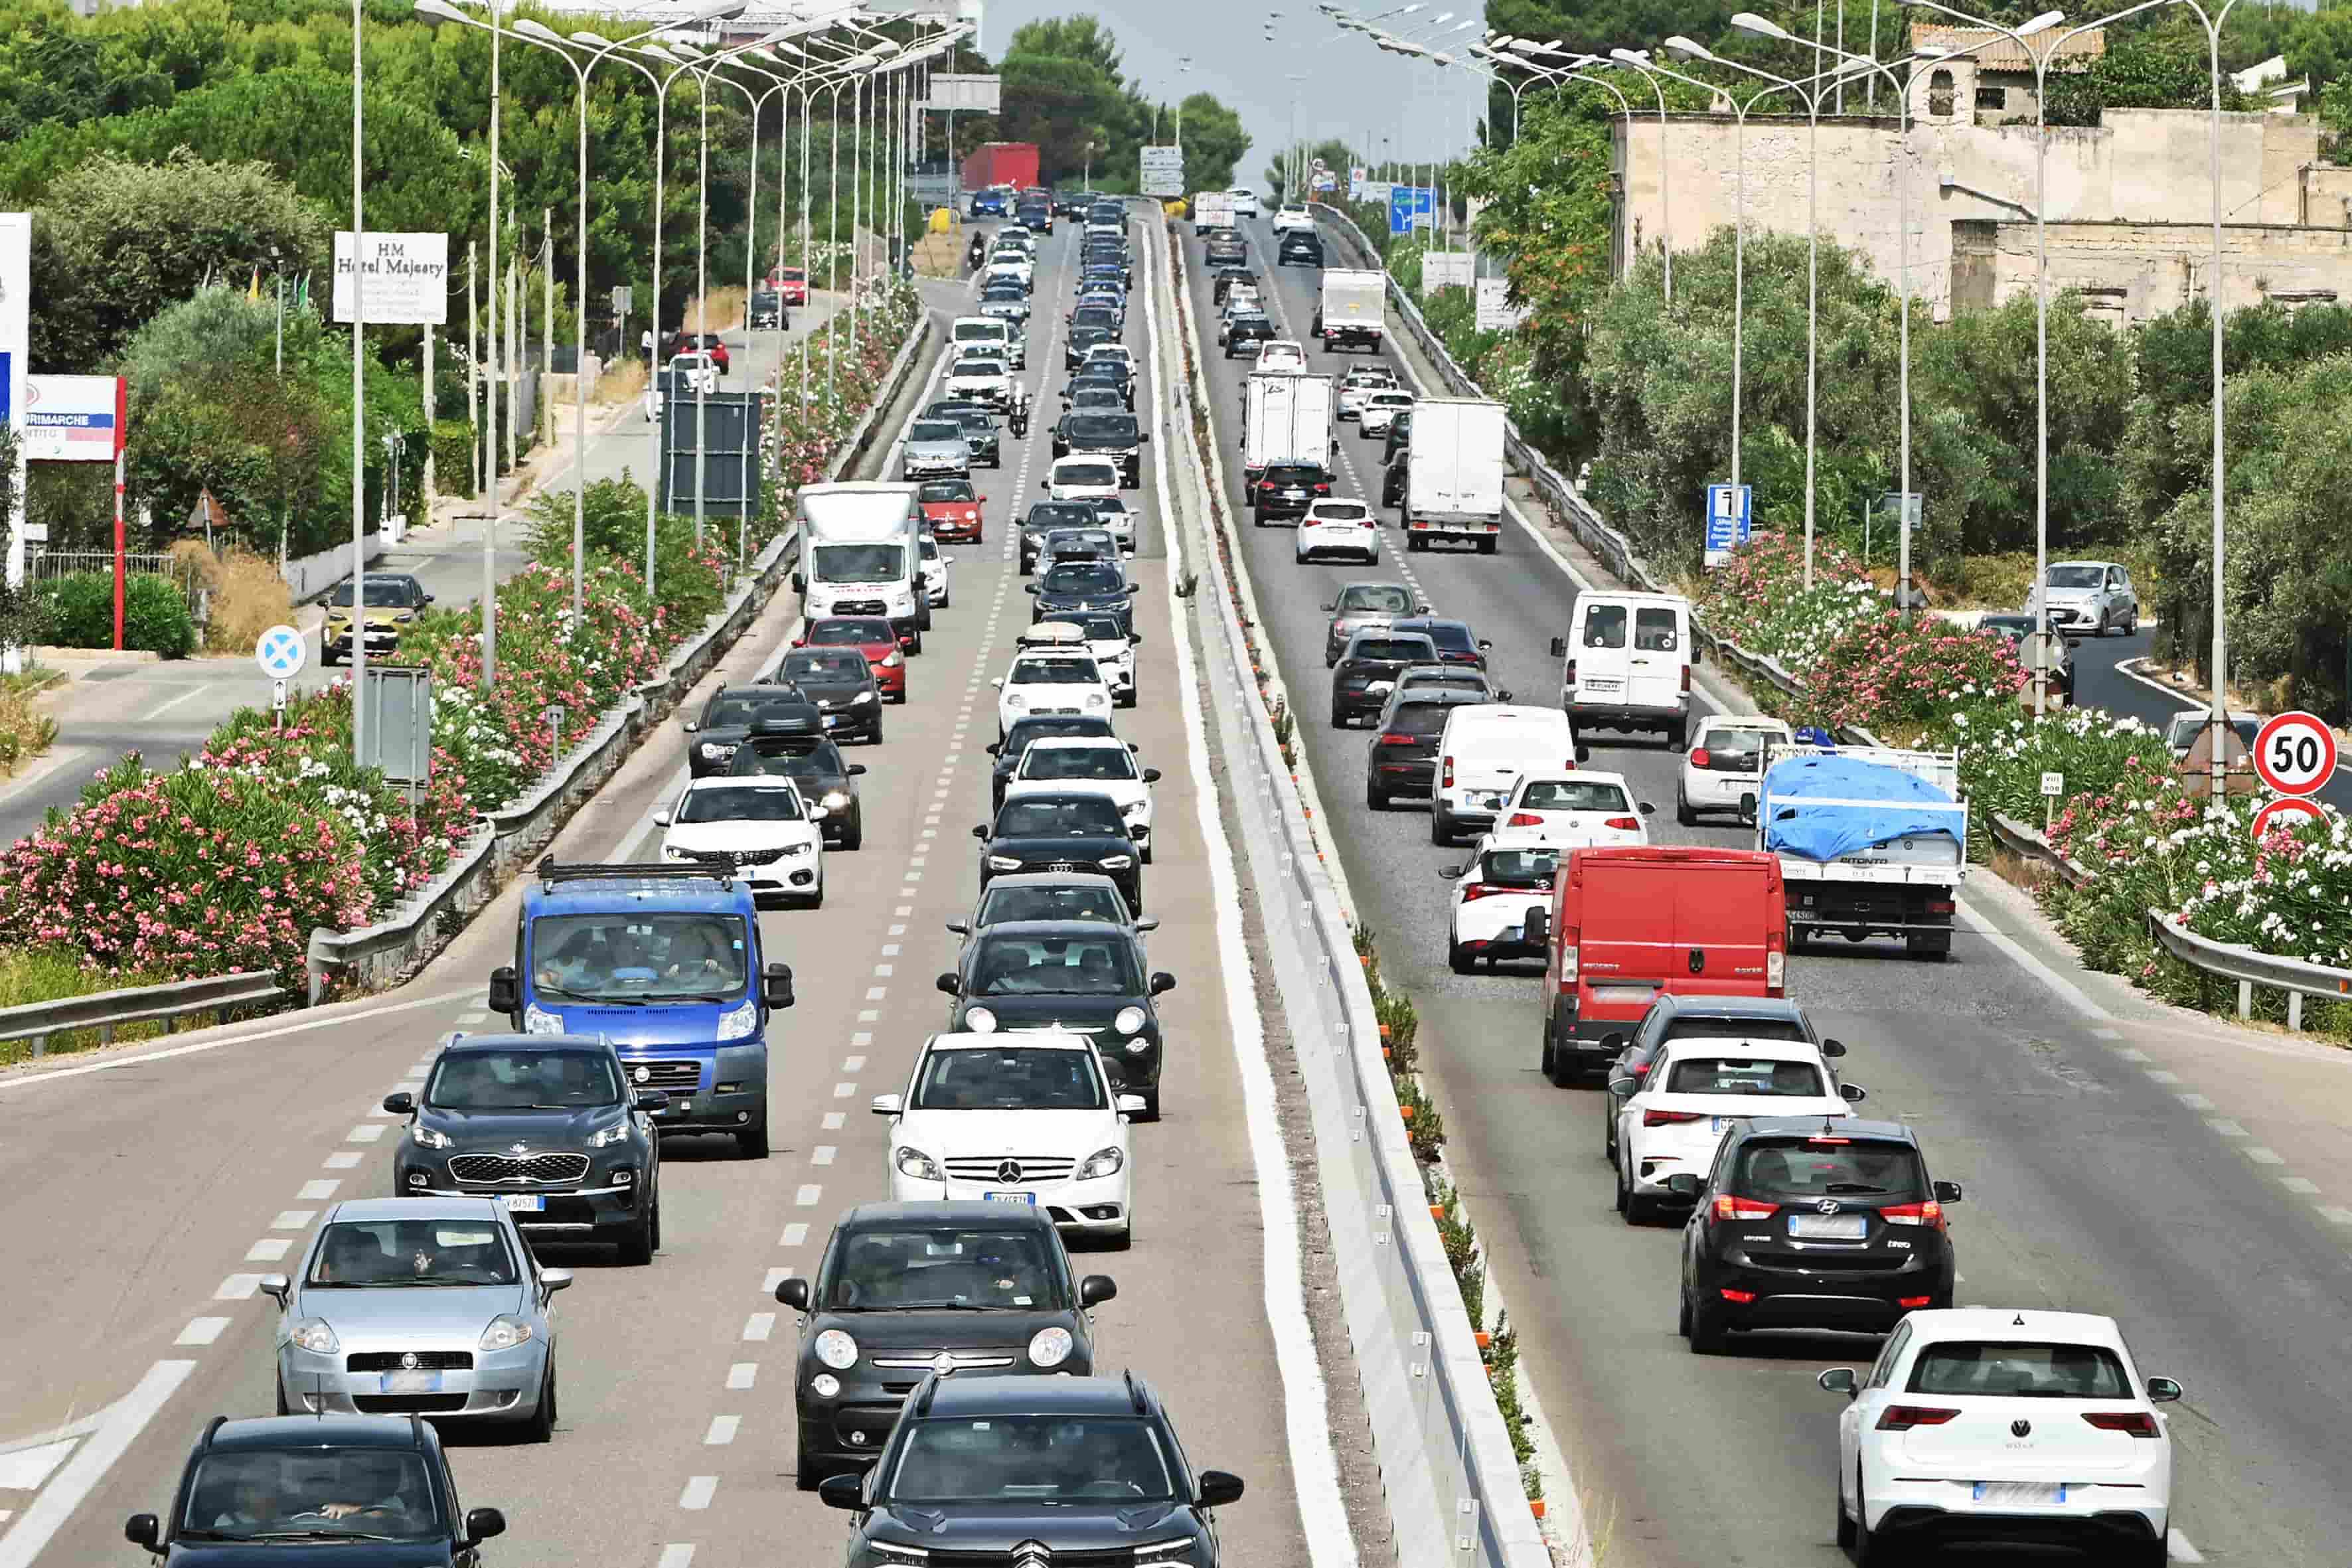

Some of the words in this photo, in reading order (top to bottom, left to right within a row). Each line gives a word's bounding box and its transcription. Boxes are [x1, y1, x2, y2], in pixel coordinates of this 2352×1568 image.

[378, 243, 404, 256] HM
[386, 258, 444, 279] Majesty
[2272, 736, 2318, 773] 50
